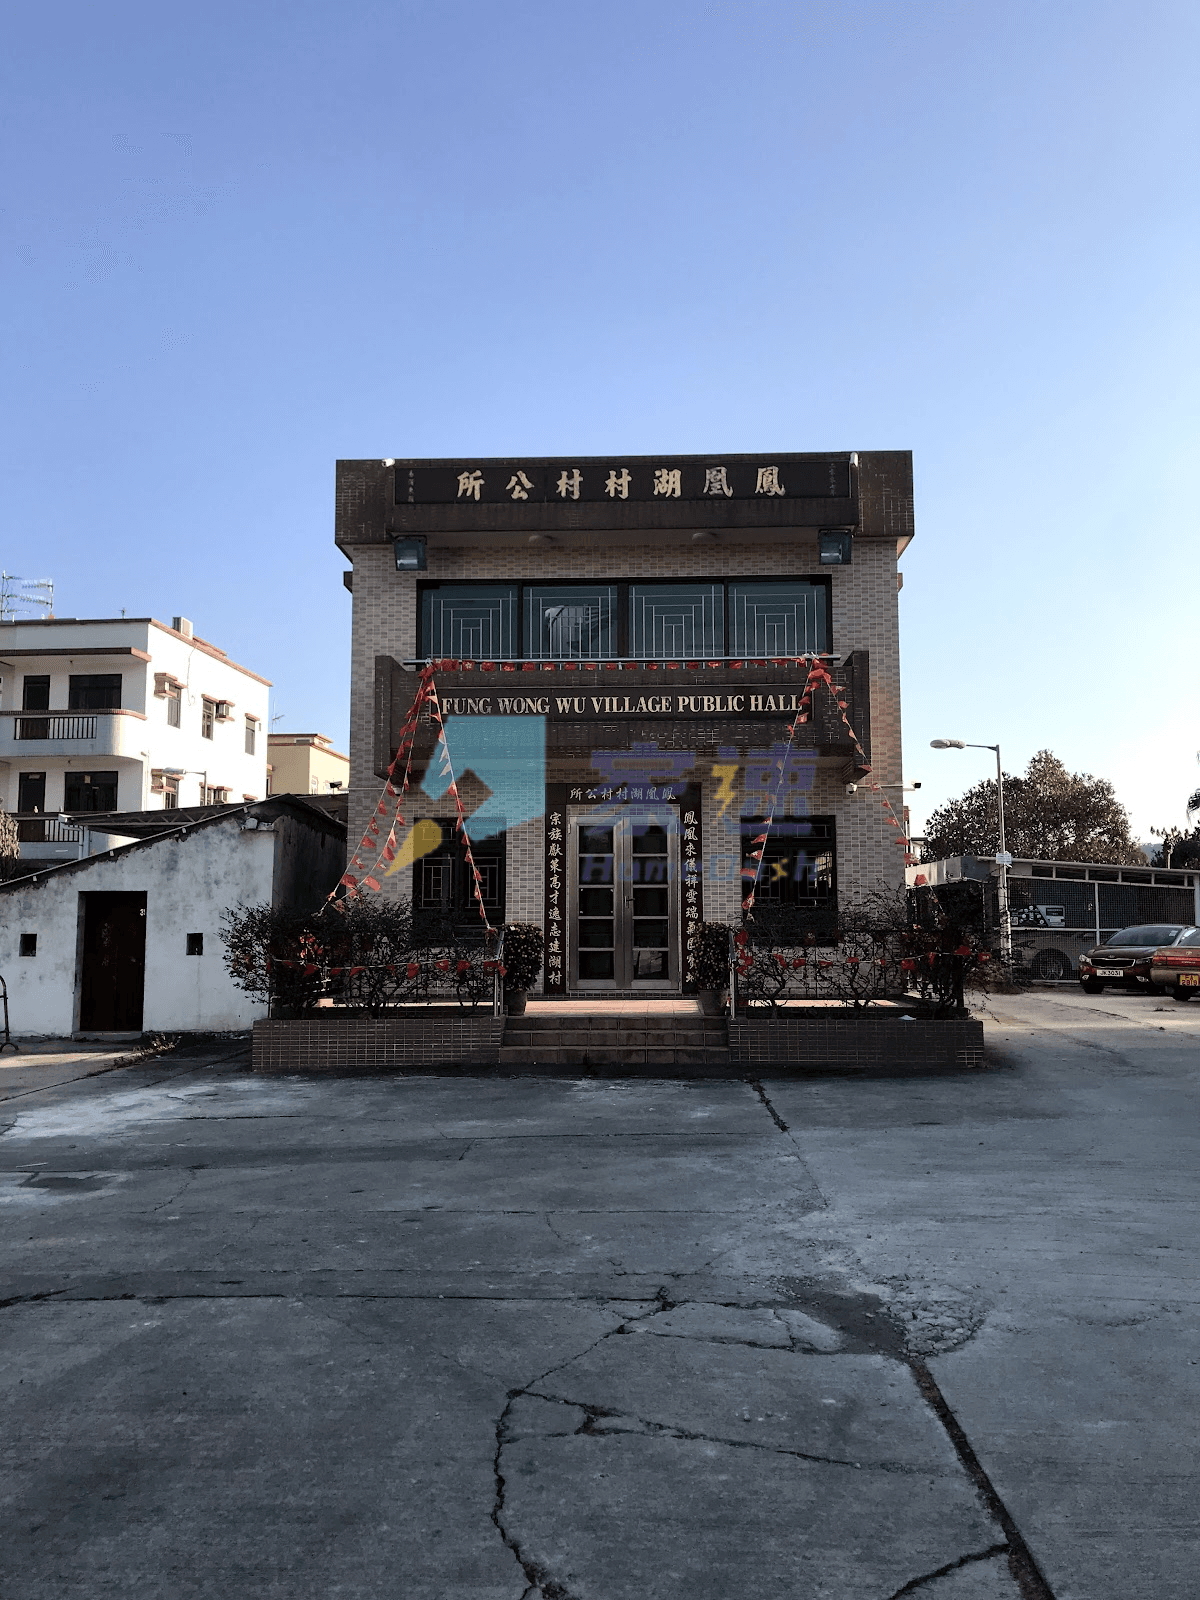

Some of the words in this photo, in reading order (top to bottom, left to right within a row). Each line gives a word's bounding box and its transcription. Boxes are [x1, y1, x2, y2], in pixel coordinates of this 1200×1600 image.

[442, 697, 492, 715] FUNG
[497, 697, 550, 714] WONG
[555, 697, 587, 714] WU
[591, 696, 672, 713] VILLAGE
[677, 695, 745, 712] PUBLIC
[750, 694, 803, 711] HALL
